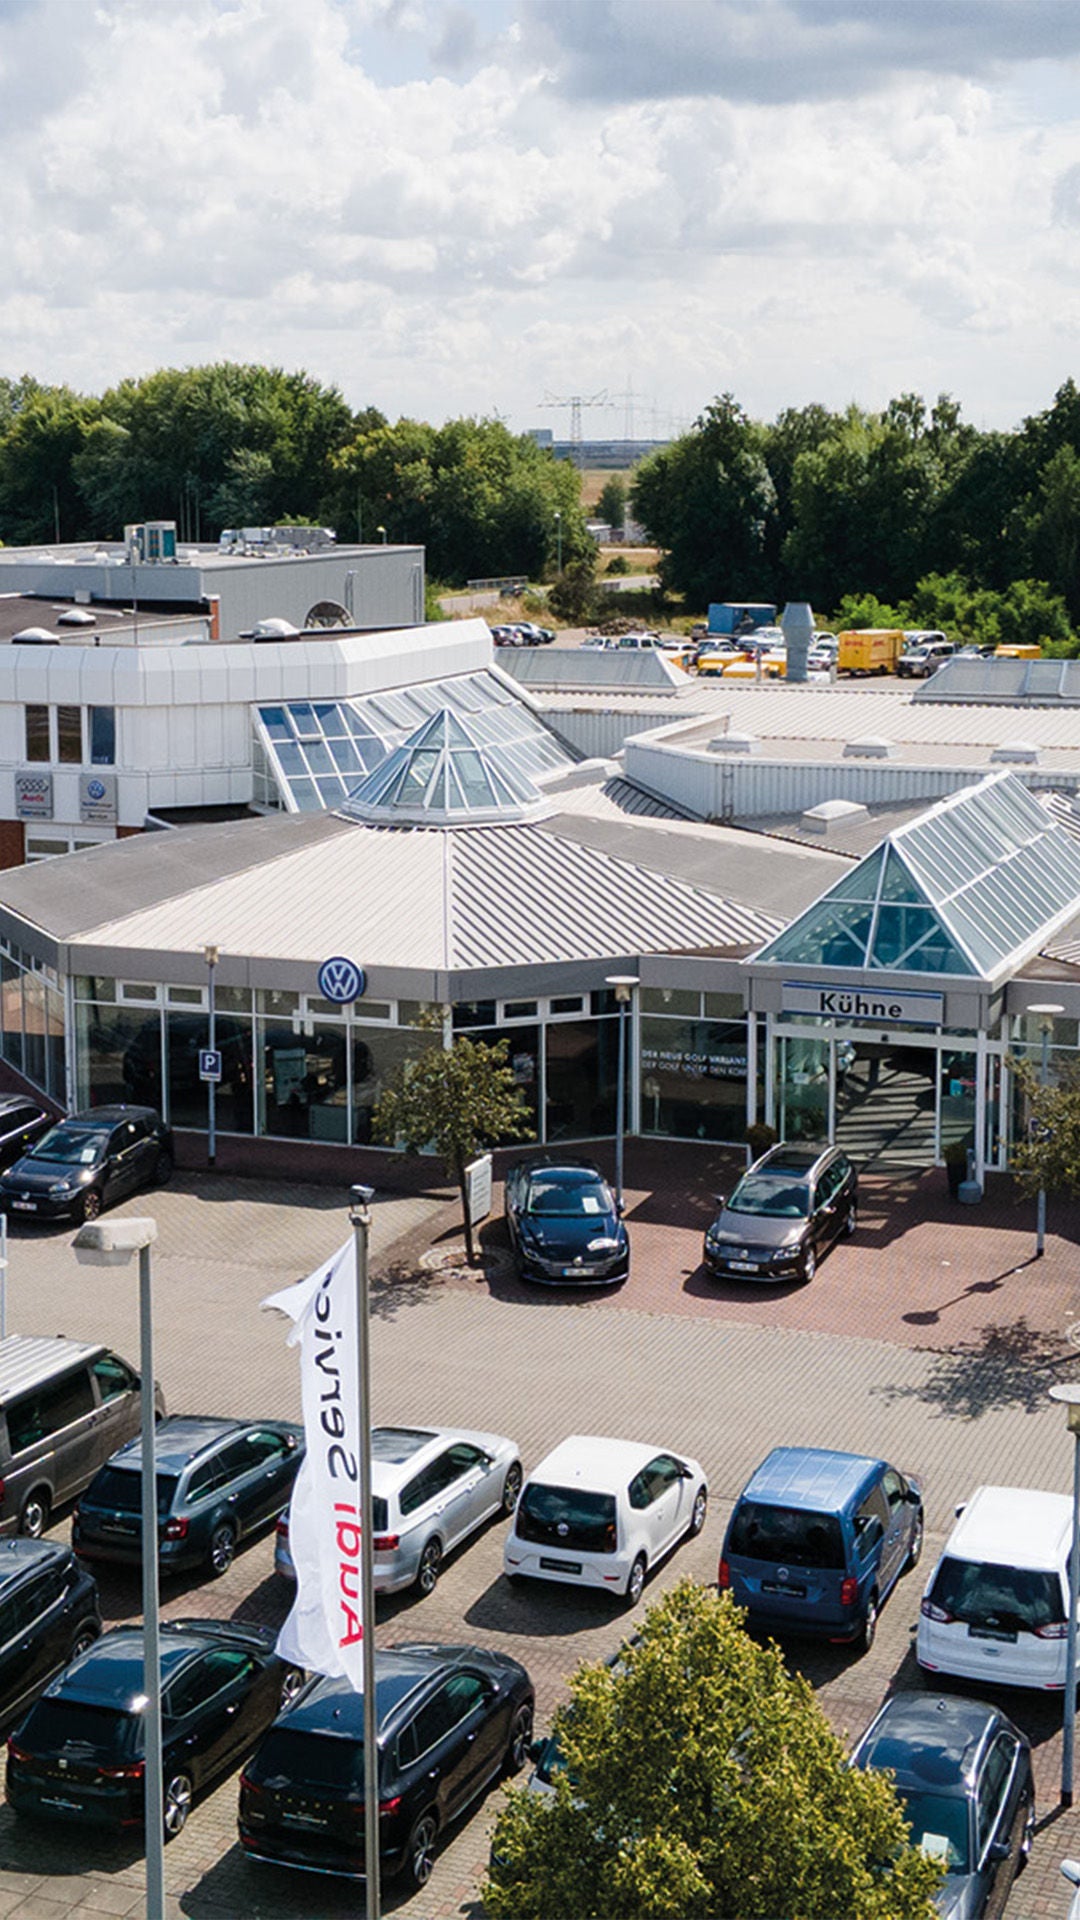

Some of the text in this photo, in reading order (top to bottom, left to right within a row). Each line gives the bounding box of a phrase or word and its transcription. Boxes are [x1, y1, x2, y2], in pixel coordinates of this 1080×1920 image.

[819, 992, 903, 1018] Kühne
[205, 1055, 216, 1070] P
[684, 1053, 707, 1062] GOLF
[658, 1061, 680, 1071] GOLF
